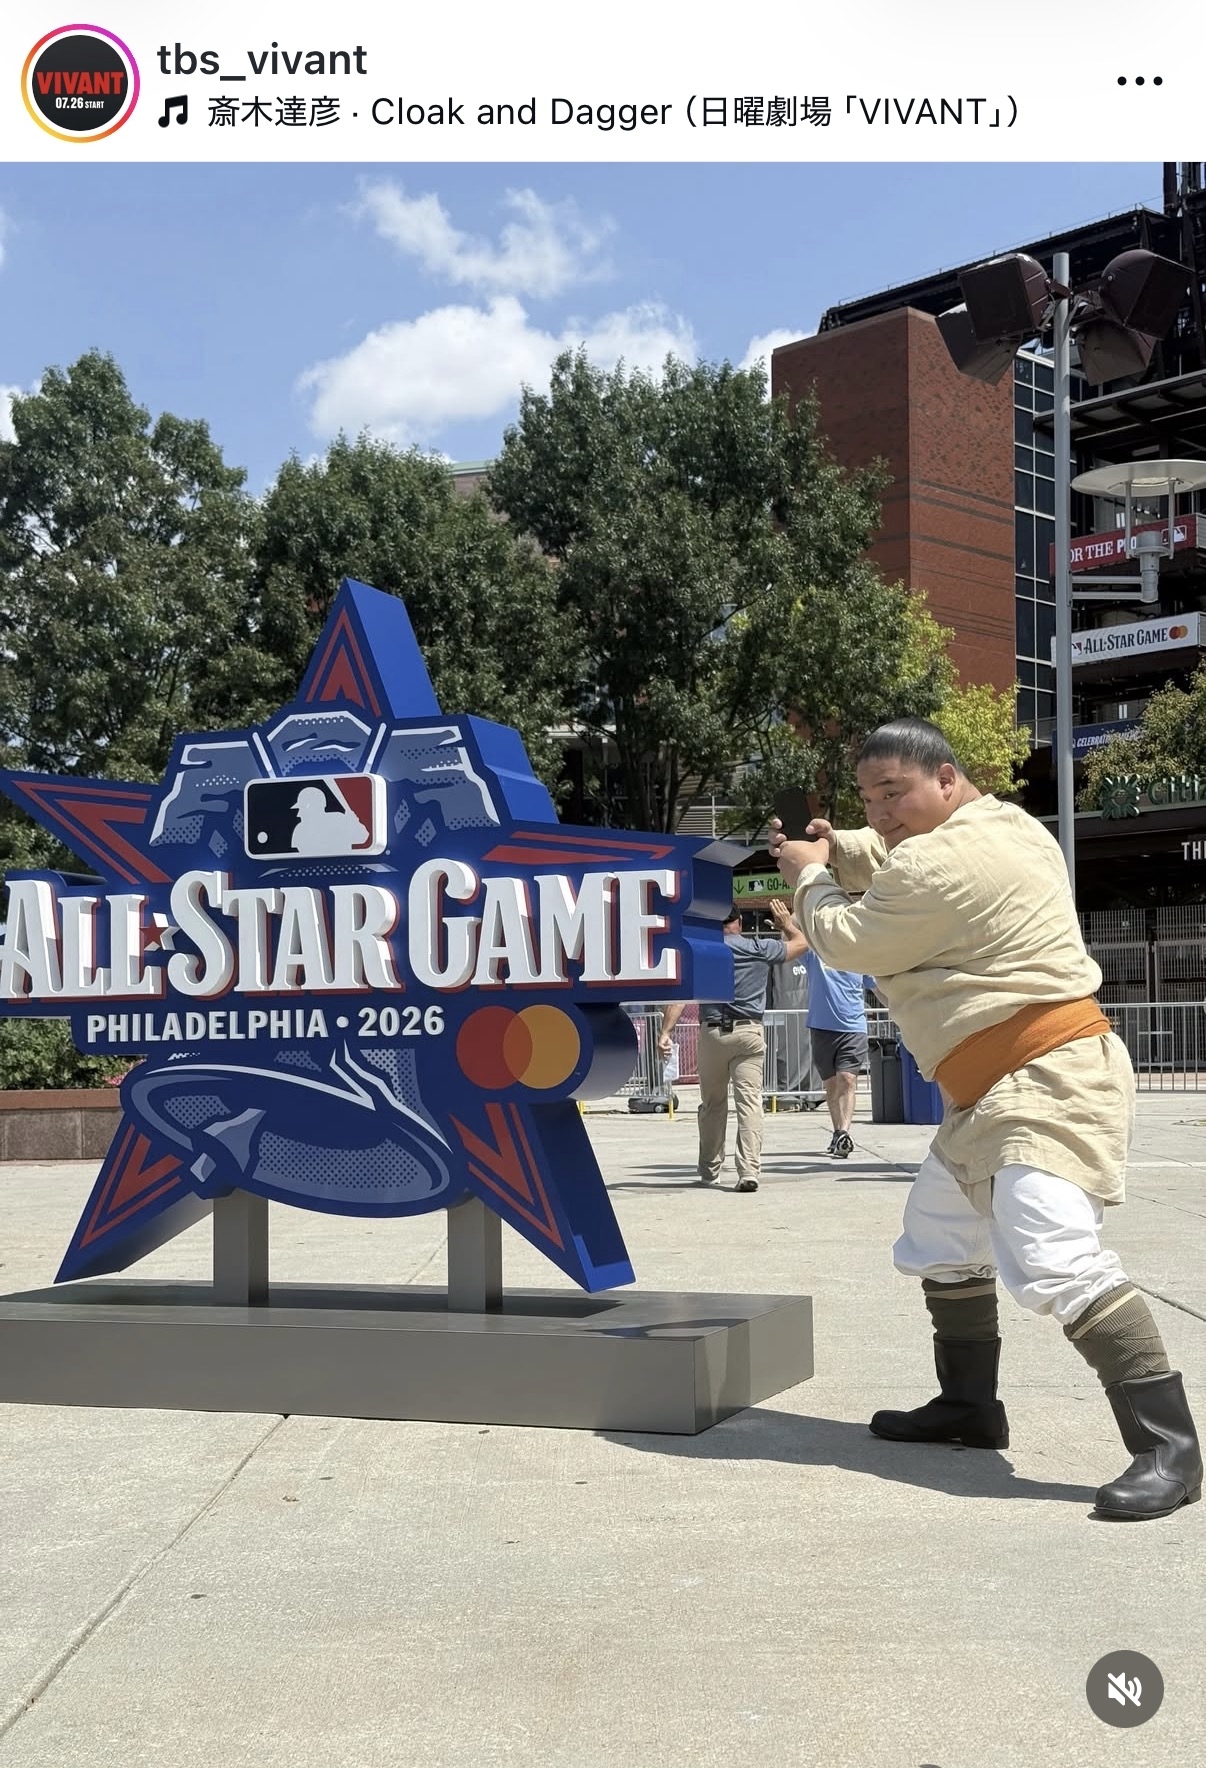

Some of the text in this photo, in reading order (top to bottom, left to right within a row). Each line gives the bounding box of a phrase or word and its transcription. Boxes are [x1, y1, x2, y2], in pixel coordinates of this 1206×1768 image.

[1085, 541, 1113, 559] THE
[1137, 627, 1168, 646] GAME
[1181, 841, 1206, 861] TH
[408, 858, 677, 988] GAME
[87, 1005, 445, 1043] PHILADELPHIA 2026
